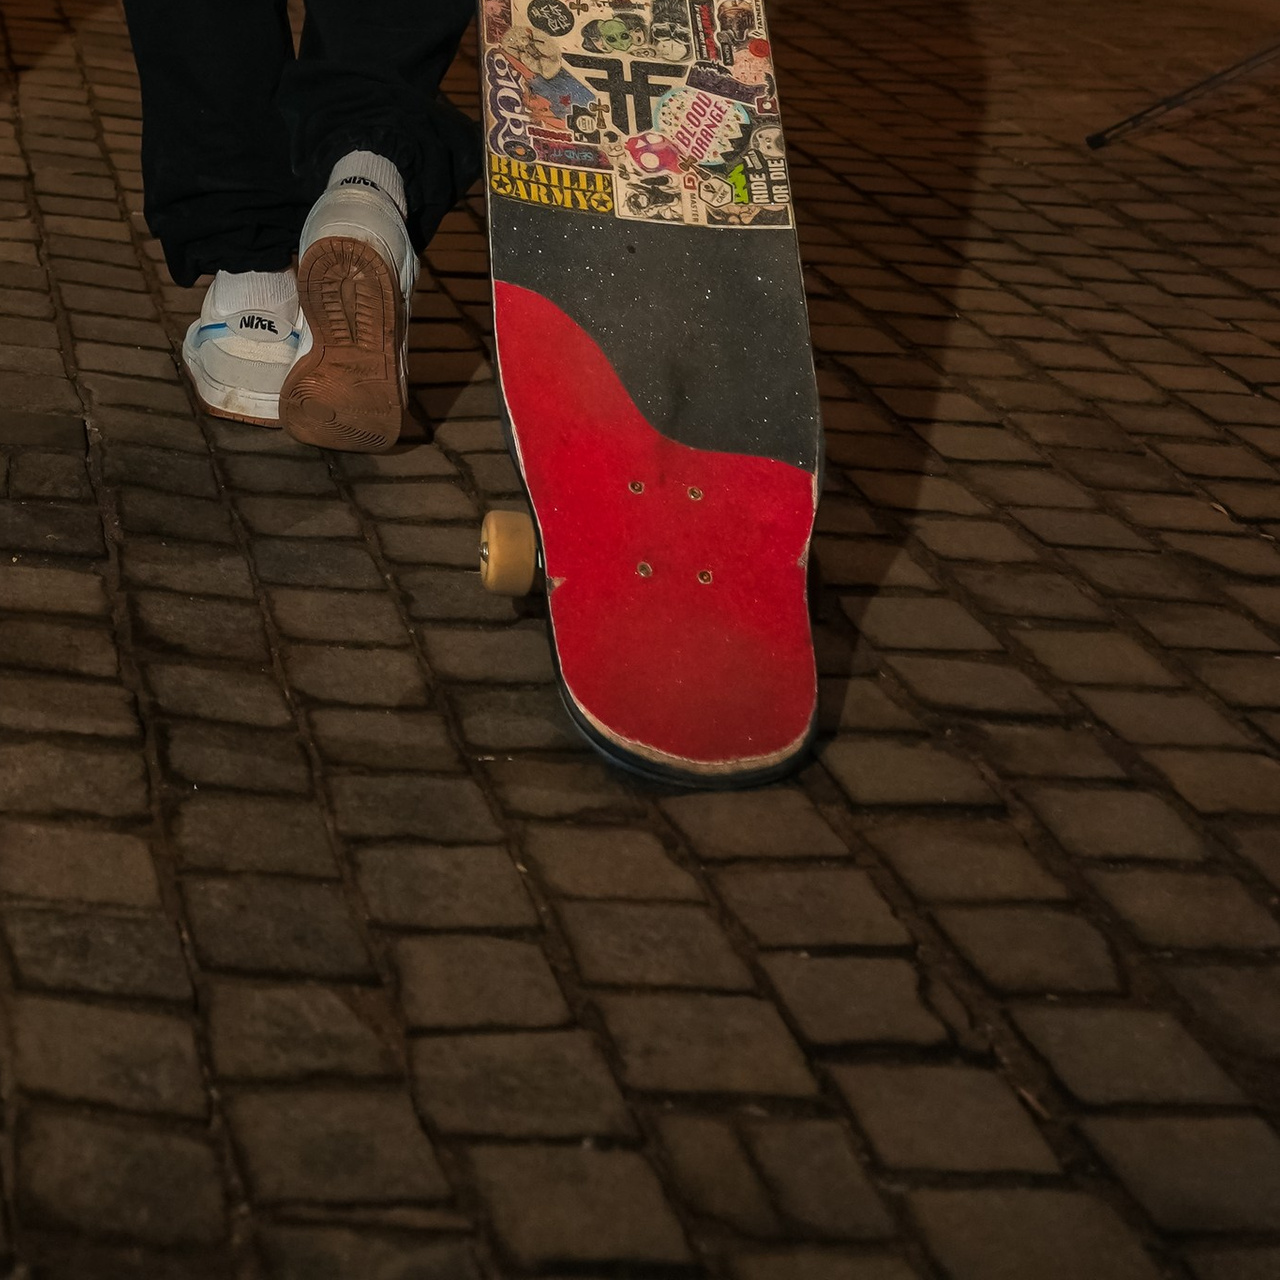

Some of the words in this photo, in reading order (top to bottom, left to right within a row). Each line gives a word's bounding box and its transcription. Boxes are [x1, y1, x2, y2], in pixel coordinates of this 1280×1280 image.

[675, 91, 712, 149] BLOOD
[691, 100, 728, 160] ORANGE
[490, 153, 612, 193] BRAILLE
[767, 158, 788, 182] DIE
[509, 179, 590, 211] ARMY
[750, 172, 770, 204] RIDE
[773, 183, 790, 203] OR
[688, 192, 700, 223] MASTER
